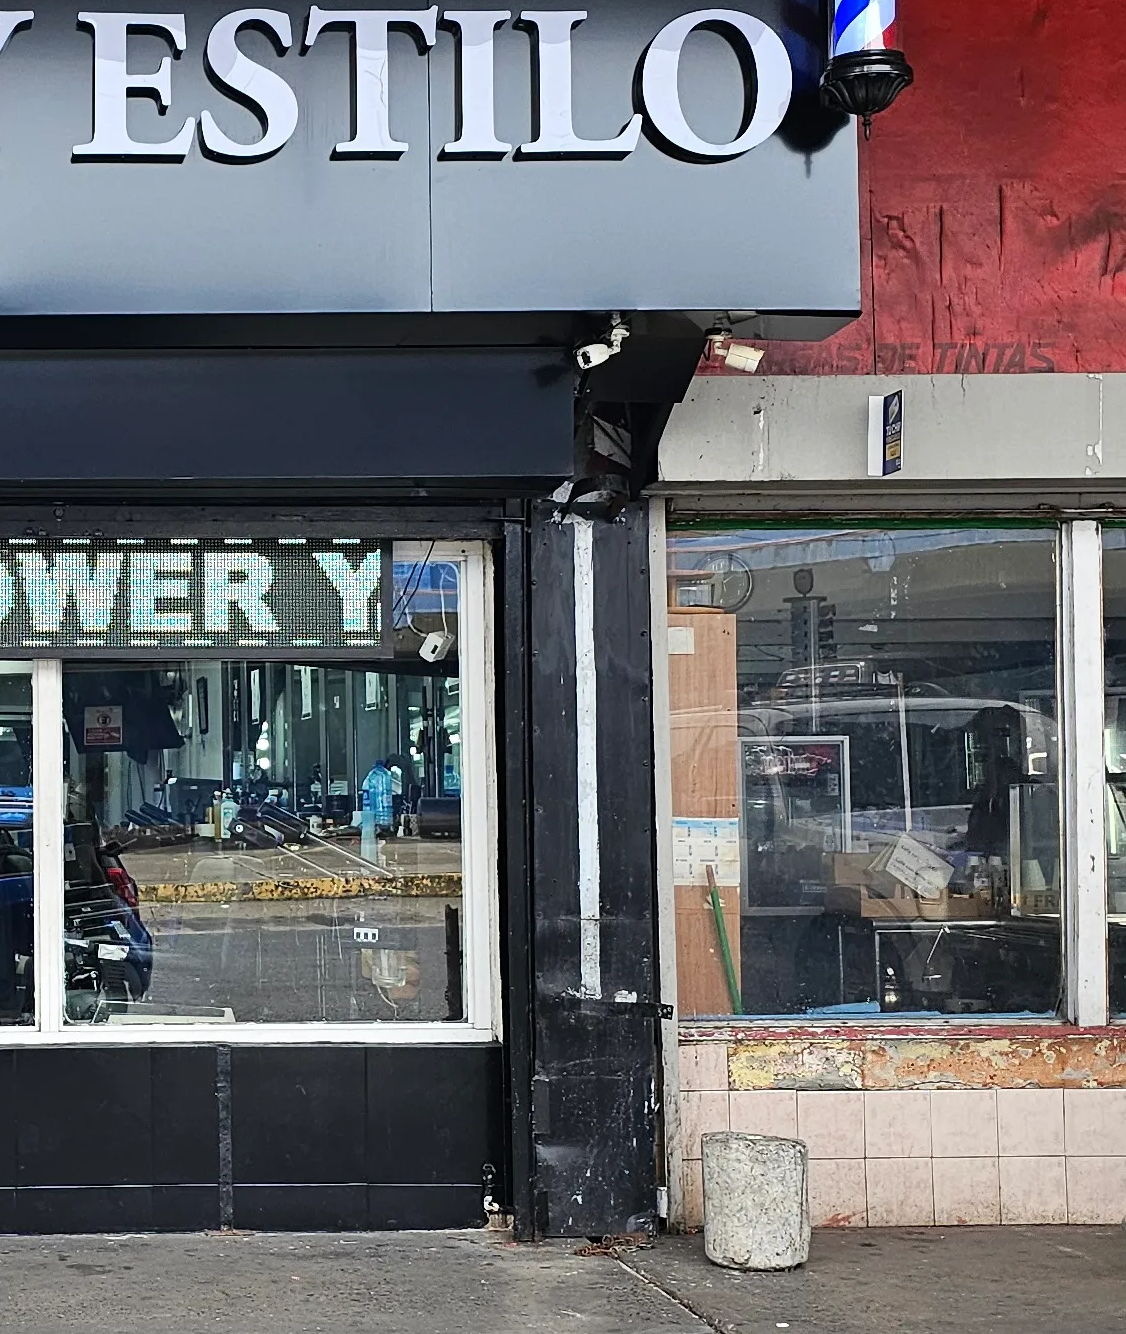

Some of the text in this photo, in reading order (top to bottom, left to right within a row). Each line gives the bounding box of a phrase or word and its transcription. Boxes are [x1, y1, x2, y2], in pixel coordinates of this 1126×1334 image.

[71, 3, 794, 159] ESTILO
[932, 341, 1057, 373] TINTAS
[311, 548, 382, 633] Y
